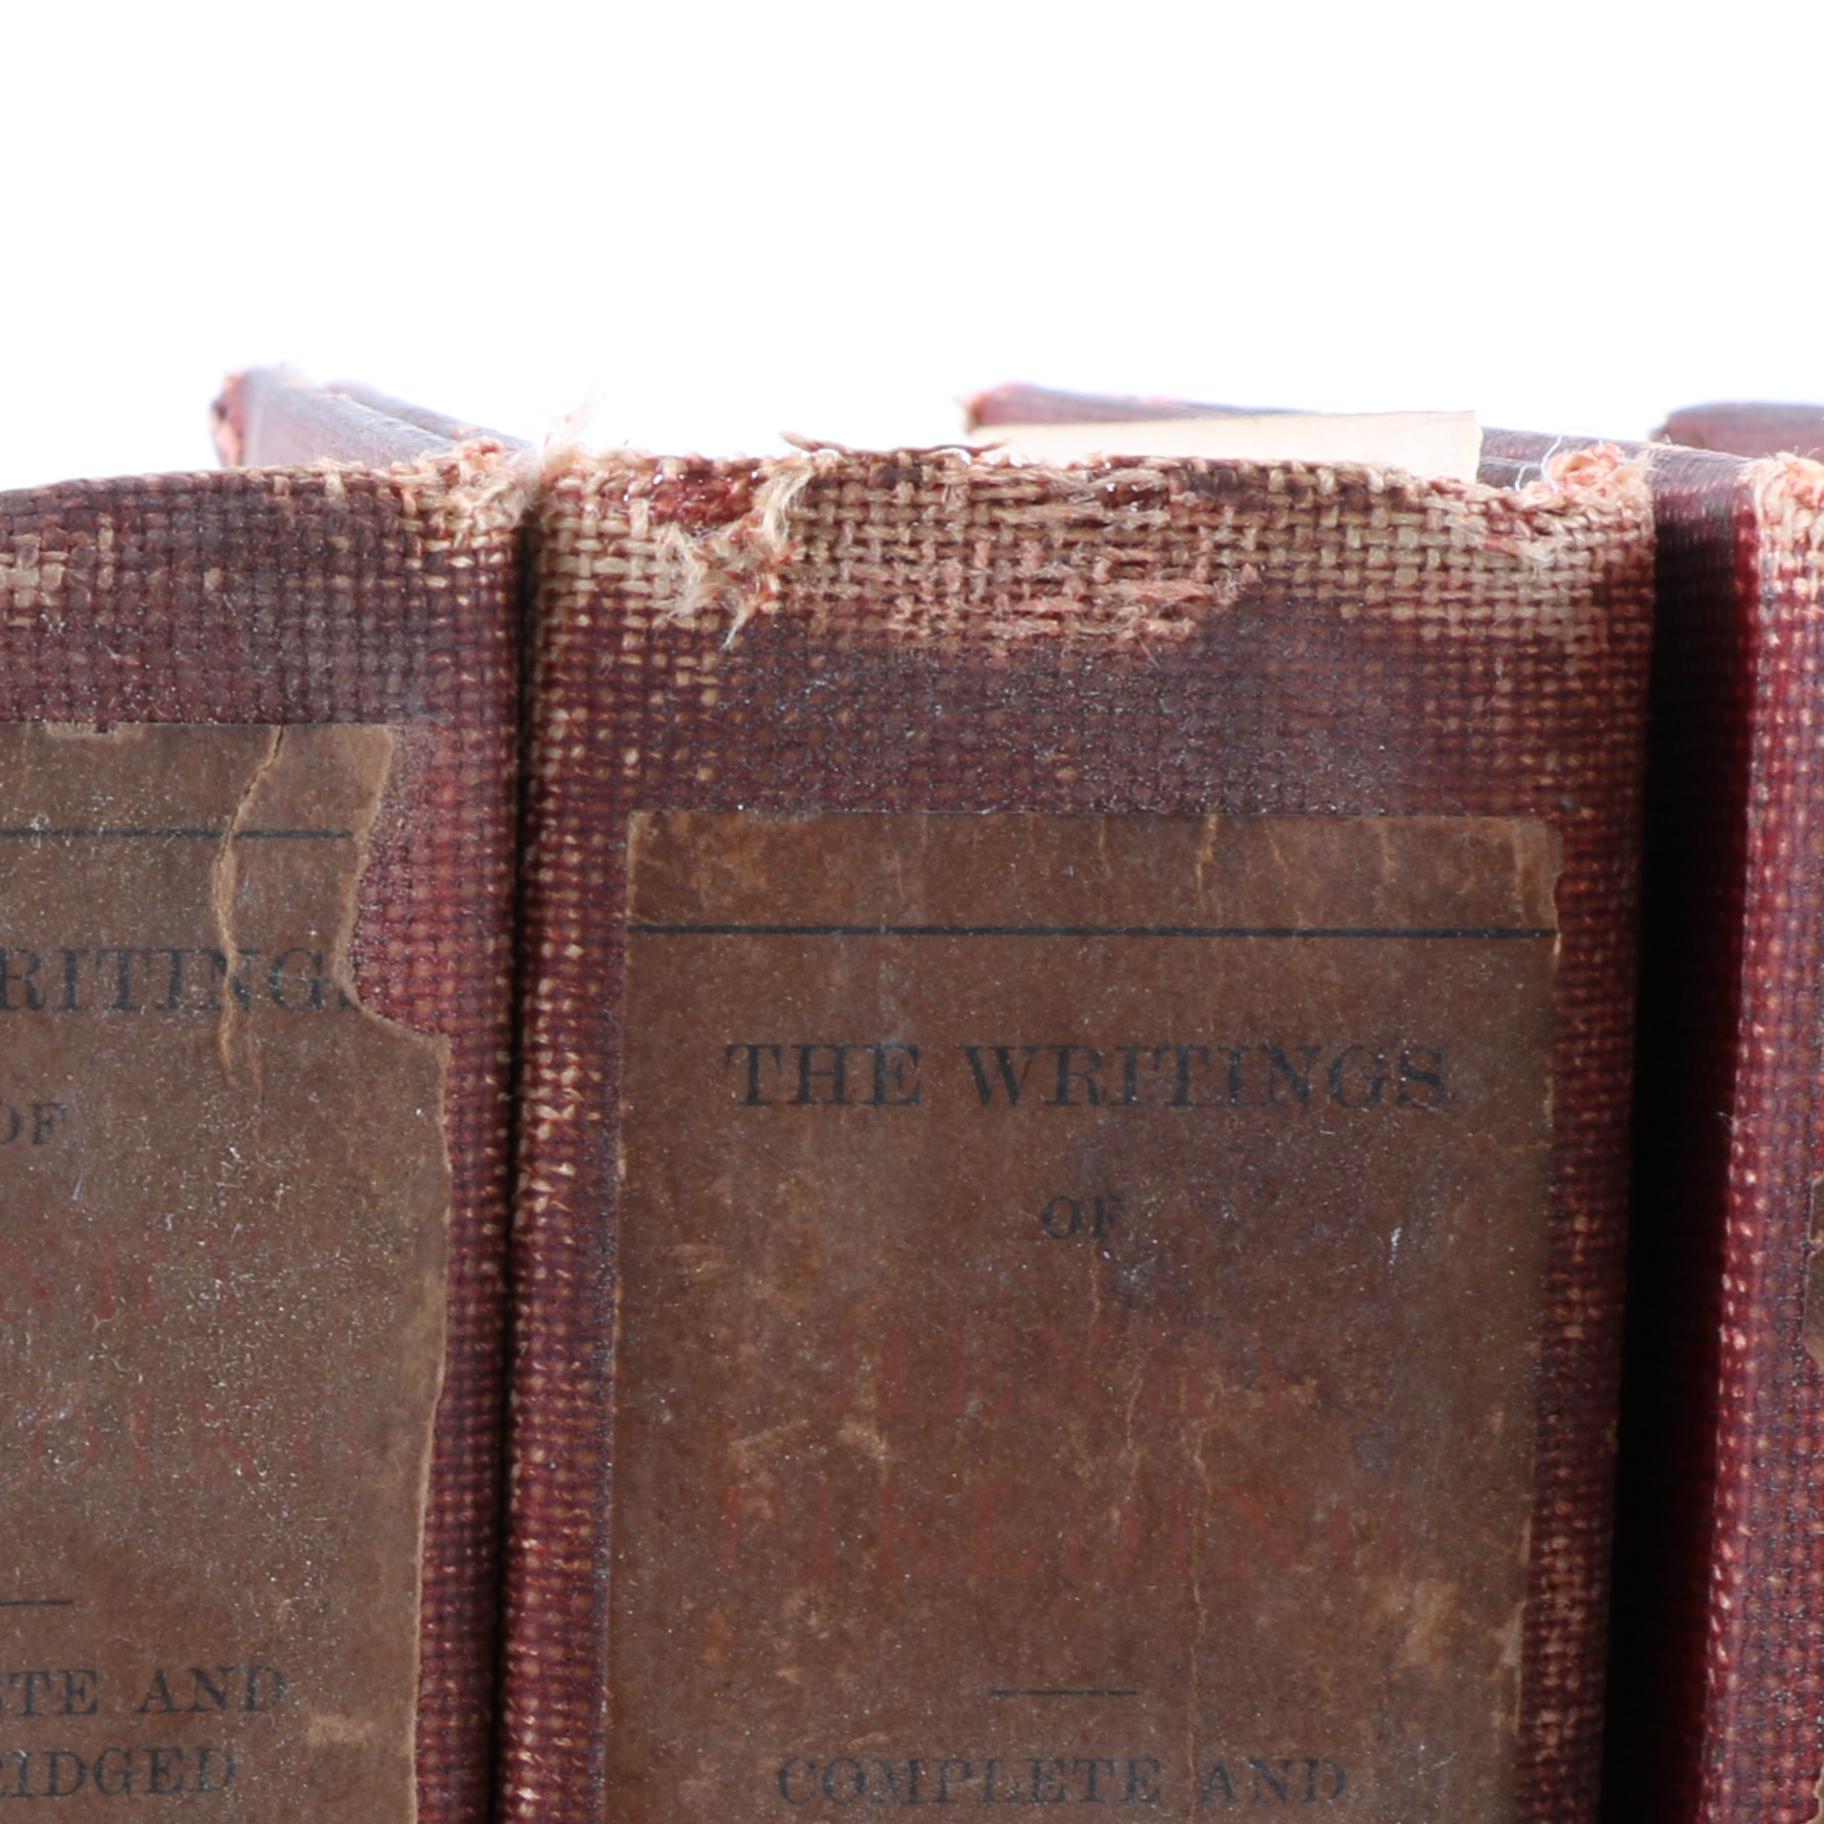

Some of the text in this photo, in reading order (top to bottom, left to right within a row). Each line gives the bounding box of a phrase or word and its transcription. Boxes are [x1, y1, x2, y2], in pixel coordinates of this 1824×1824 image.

[725, 1042, 1449, 1111] THE WRITINGS
[1041, 1195, 1126, 1240] OF
[136, 1665, 286, 1714] AND
[777, 1756, 1347, 1805] COMPLETE AND
